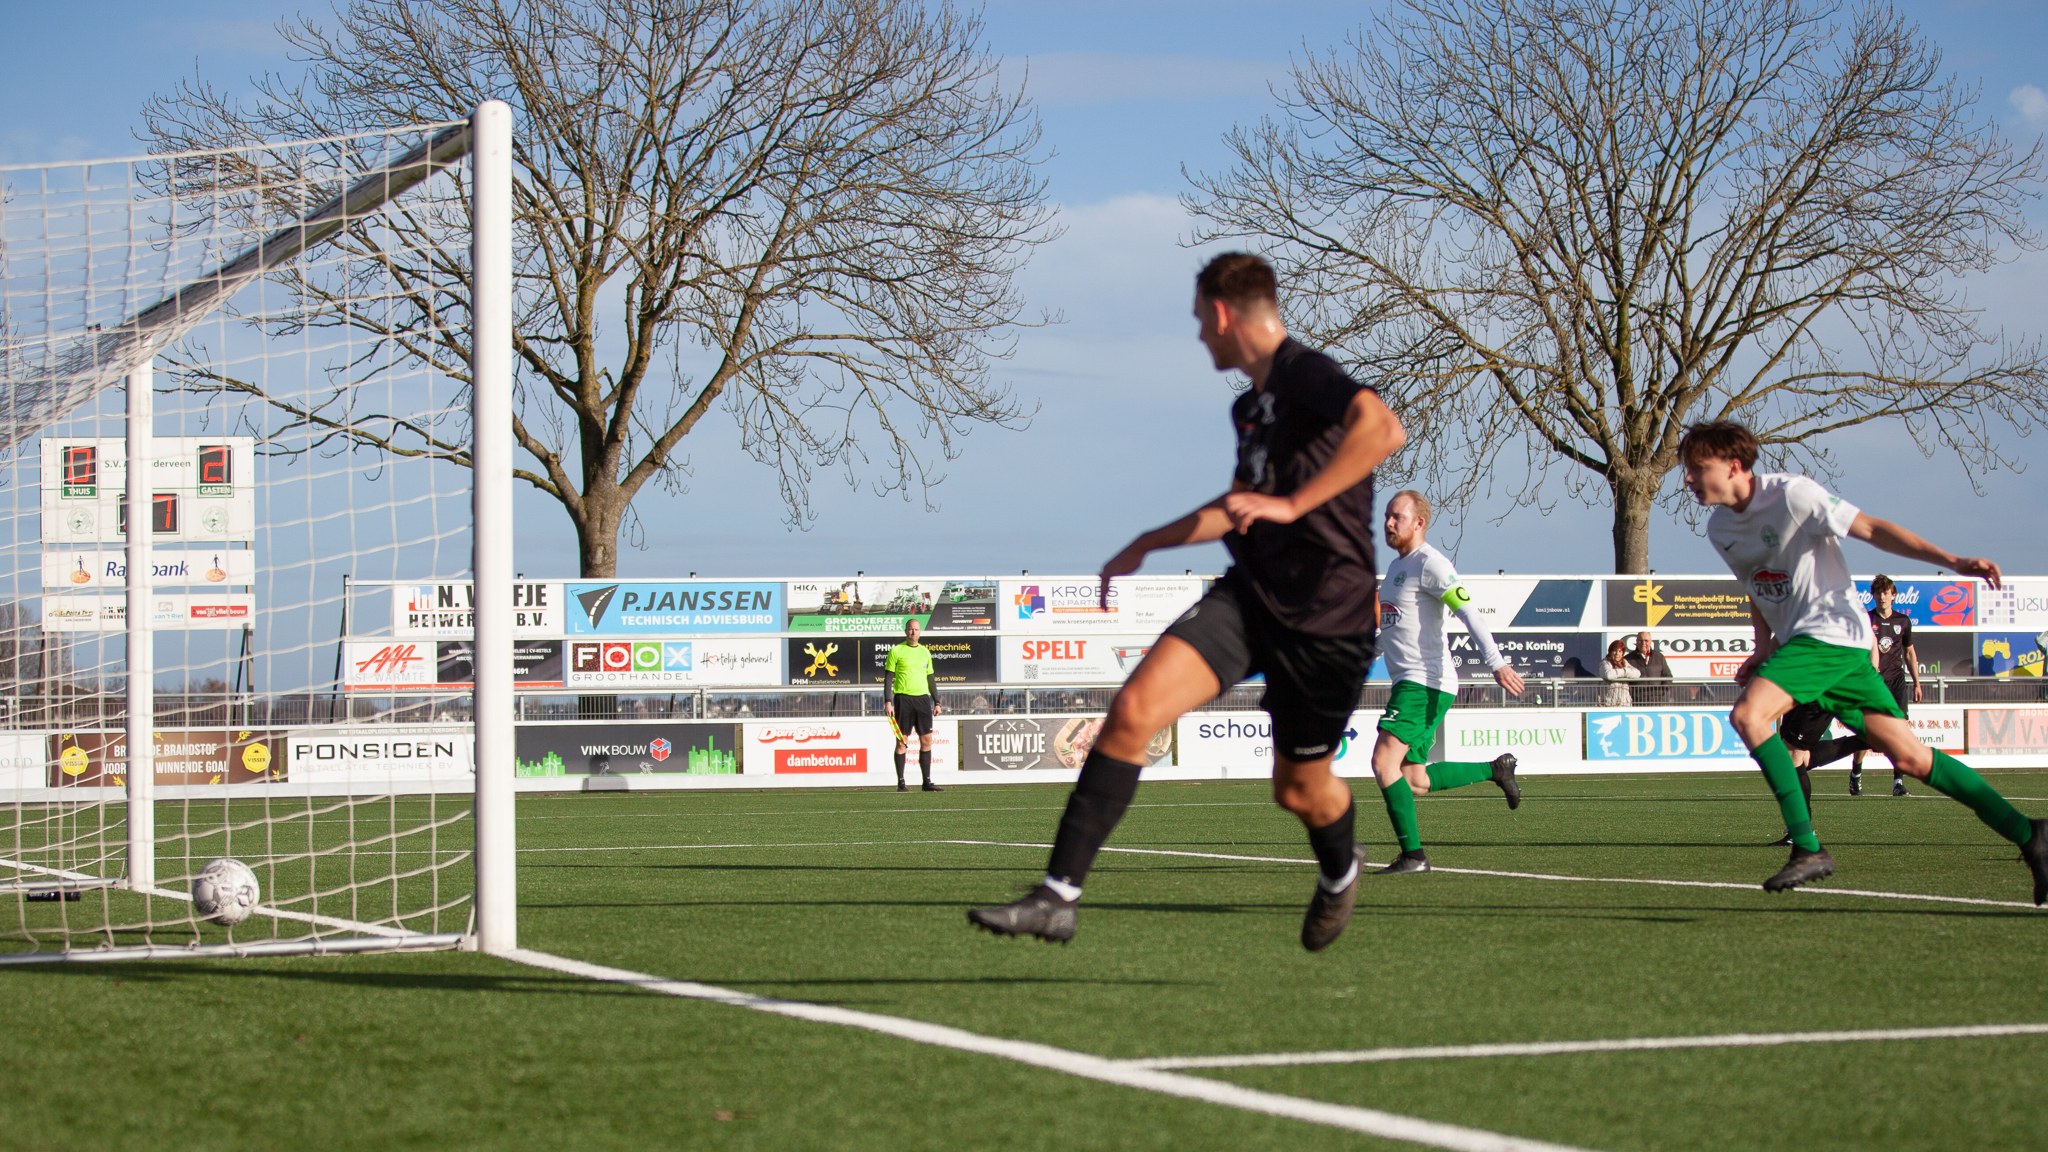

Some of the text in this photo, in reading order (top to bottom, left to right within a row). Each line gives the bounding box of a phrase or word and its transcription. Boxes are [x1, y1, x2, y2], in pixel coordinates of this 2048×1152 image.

[67, 447, 91, 483] 0
[104, 460, 121, 468] S.V.
[203, 446, 226, 482] 2
[68, 487, 91, 496] THUIS
[200, 486, 231, 495] GASTEN
[106, 560, 190, 577] Rabank
[794, 584, 818, 592] HKA
[1051, 586, 1119, 598] KROES
[1456, 586, 1471, 602] C
[621, 591, 773, 612] P.JANSSEN
[1067, 599, 1119, 607] PARTNRS
[1674, 594, 1725, 604] Montagebedrijf
[1725, 595, 1744, 604] Berry
[1697, 603, 1738, 611] Gevelsystemen
[516, 612, 548, 627] B.V.
[621, 614, 774, 626] TECHNISCH ADVIESBURO
[824, 617, 904, 625] GRONDVERZET
[825, 623, 904, 632] EN LOONWERK
[1022, 640, 1088, 661] SPELT
[1525, 640, 1565, 653] Koning
[576, 644, 691, 670] FOOX
[572, 672, 693, 682] GROOTHANDEL
[1926, 720, 1941, 729] ZN.
[1943, 720, 1960, 729] B.V.
[1460, 728, 1568, 747] LBH BOUW
[1625, 713, 1724, 757] BBD
[165, 743, 218, 756] BRANDSTOF
[580, 745, 647, 756] VINK BOUW
[375, 762, 432, 771] TECHNIEK
[438, 761, 454, 769] BV
[786, 753, 857, 767] dambeton.nl
[103, 762, 127, 775] VOOR
[155, 760, 230, 774] WINNENDE GOAL
